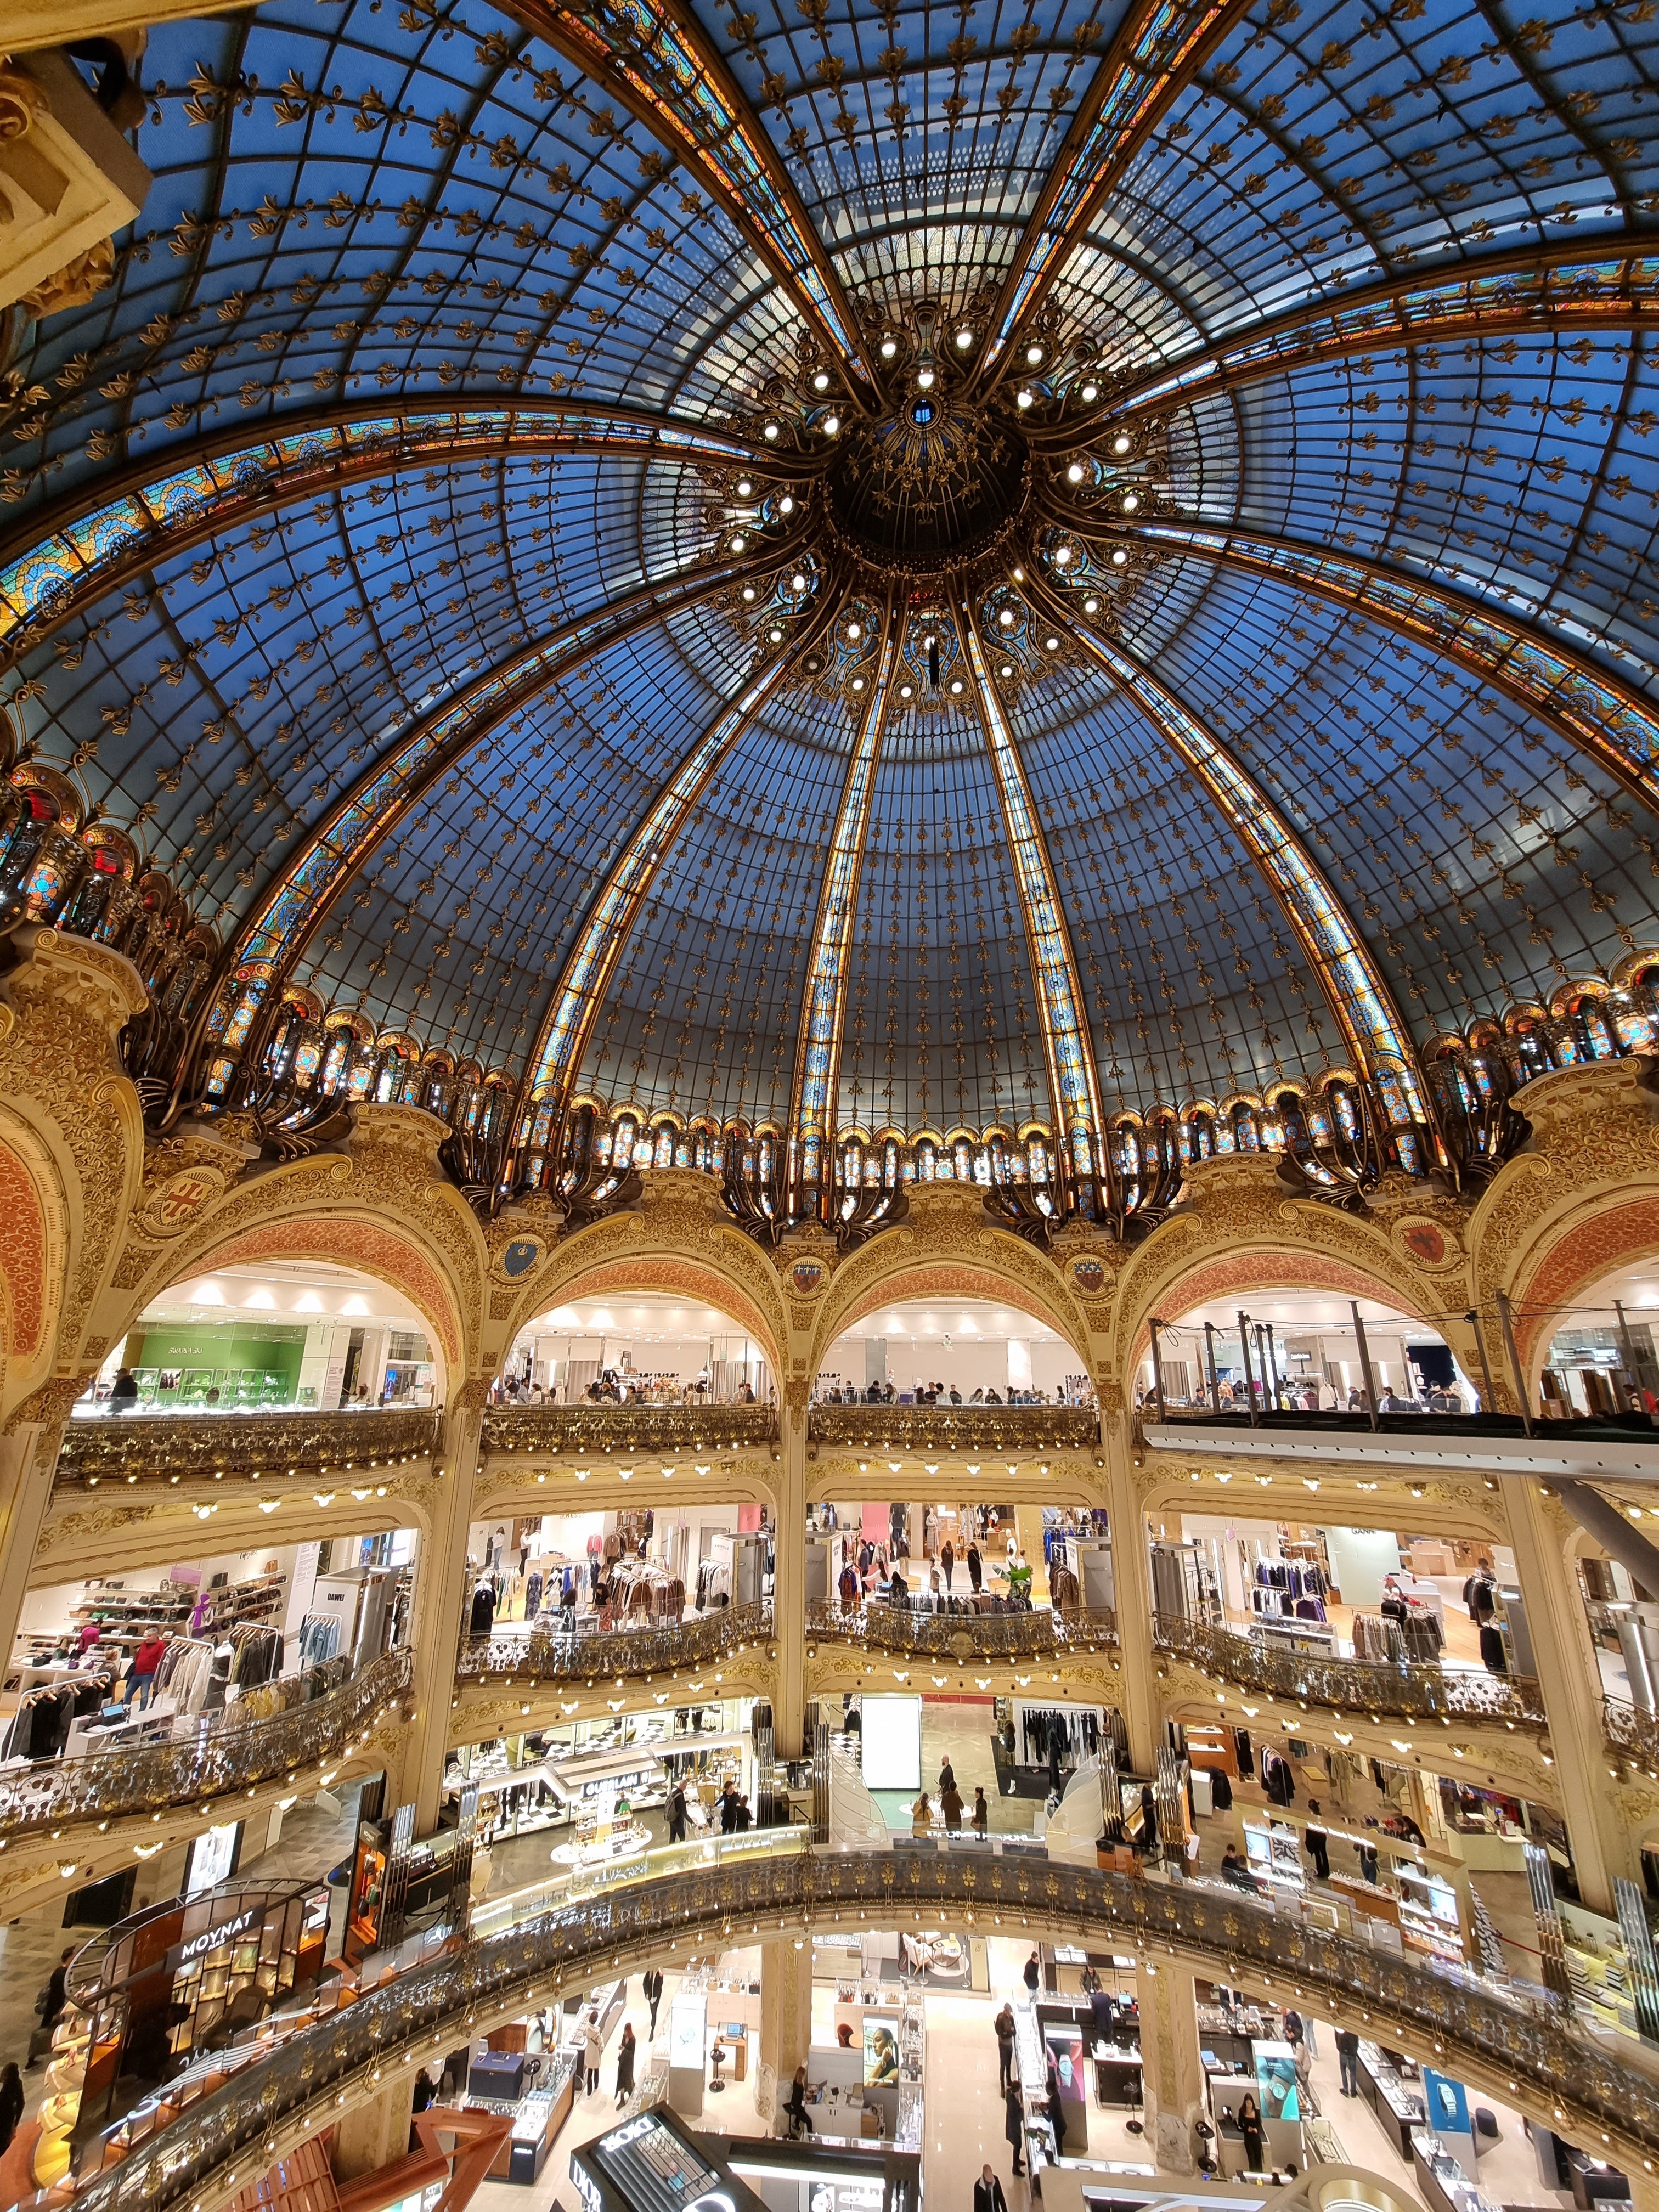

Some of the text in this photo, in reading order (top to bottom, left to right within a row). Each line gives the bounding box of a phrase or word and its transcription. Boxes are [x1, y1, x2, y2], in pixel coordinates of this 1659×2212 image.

[586, 1773, 638, 1796] GUERLAIN
[181, 1910, 253, 1960] MOYNAT
[208, 1938, 226, 1951] PARIS
[599, 2116, 655, 2152] DIOR
[573, 2160, 601, 2212] DIOR
